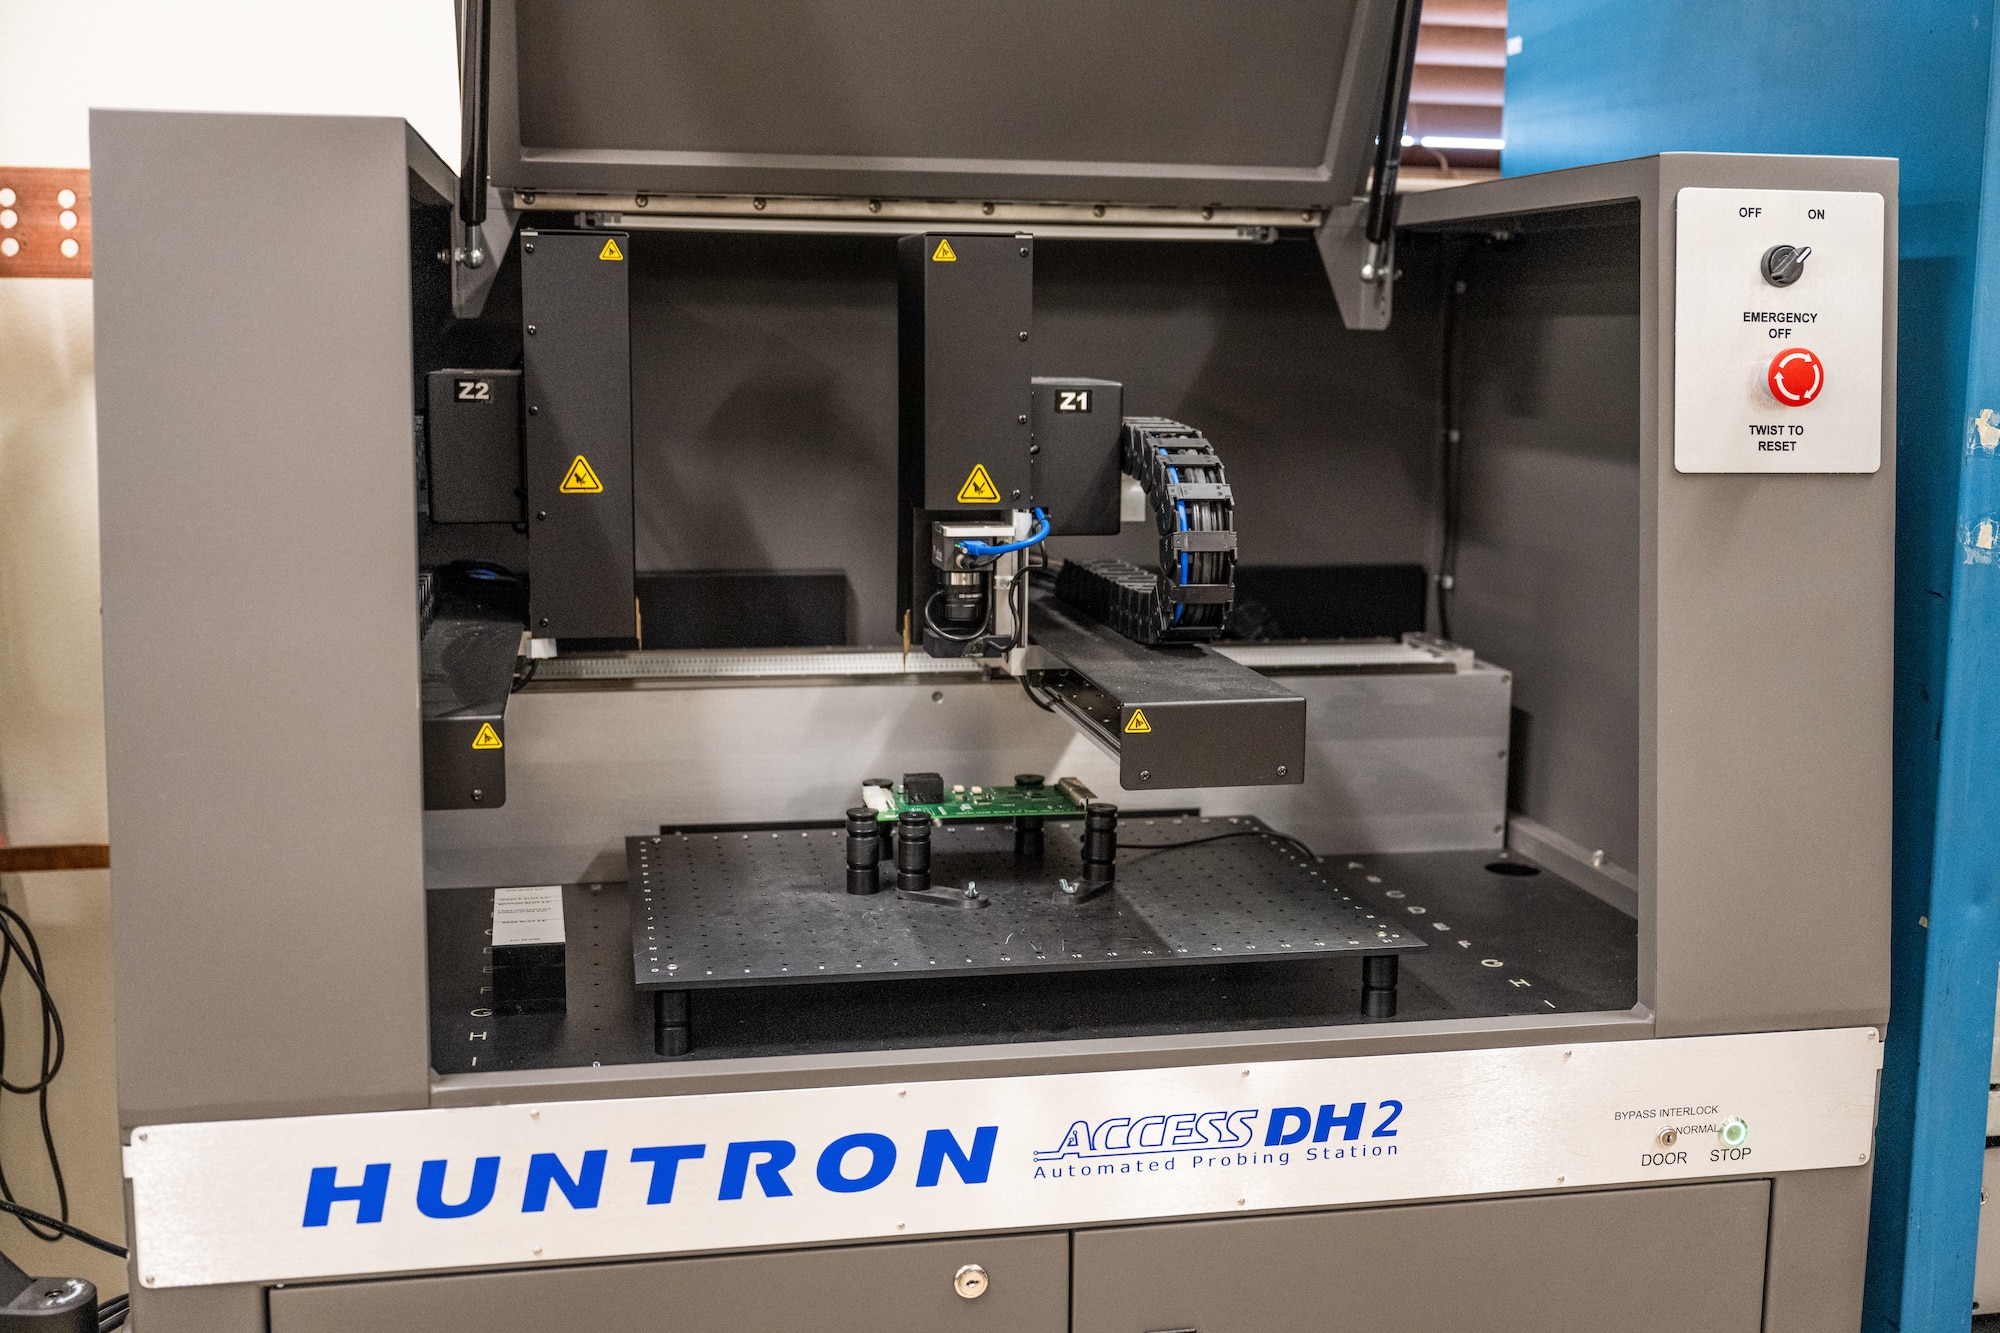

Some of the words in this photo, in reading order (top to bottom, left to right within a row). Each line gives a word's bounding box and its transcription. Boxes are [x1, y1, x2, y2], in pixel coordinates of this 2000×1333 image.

[1738, 207, 1762, 218] OFF
[1807, 209, 1825, 220] ON
[1743, 311, 1818, 324] EMERGENCY
[1768, 328, 1792, 339] OFF
[459, 382, 490, 400] Z2
[1059, 391, 1088, 410] Z1
[1748, 424, 1785, 436] TWIST
[1787, 425, 1804, 436] TO
[1758, 440, 1797, 452] RESET
[1481, 958, 1504, 968] G
[1508, 978, 1531, 988] H
[470, 1008, 492, 1017] G
[469, 1031, 487, 1041] H
[1614, 1109, 1656, 1121] BYPASS
[1659, 1105, 1718, 1117] INTERLOCK
[1033, 1109, 1258, 1162] ACCESS
[1675, 1124, 1720, 1135] NORMAL
[1641, 1151, 1687, 1167] DOOR
[1709, 1147, 1752, 1162] STOP
[1033, 1156, 1176, 1179] Automated
[1192, 1149, 1290, 1166] Probing
[1306, 1144, 1398, 1162] Station
[302, 1126, 998, 1228] HUNTRON
